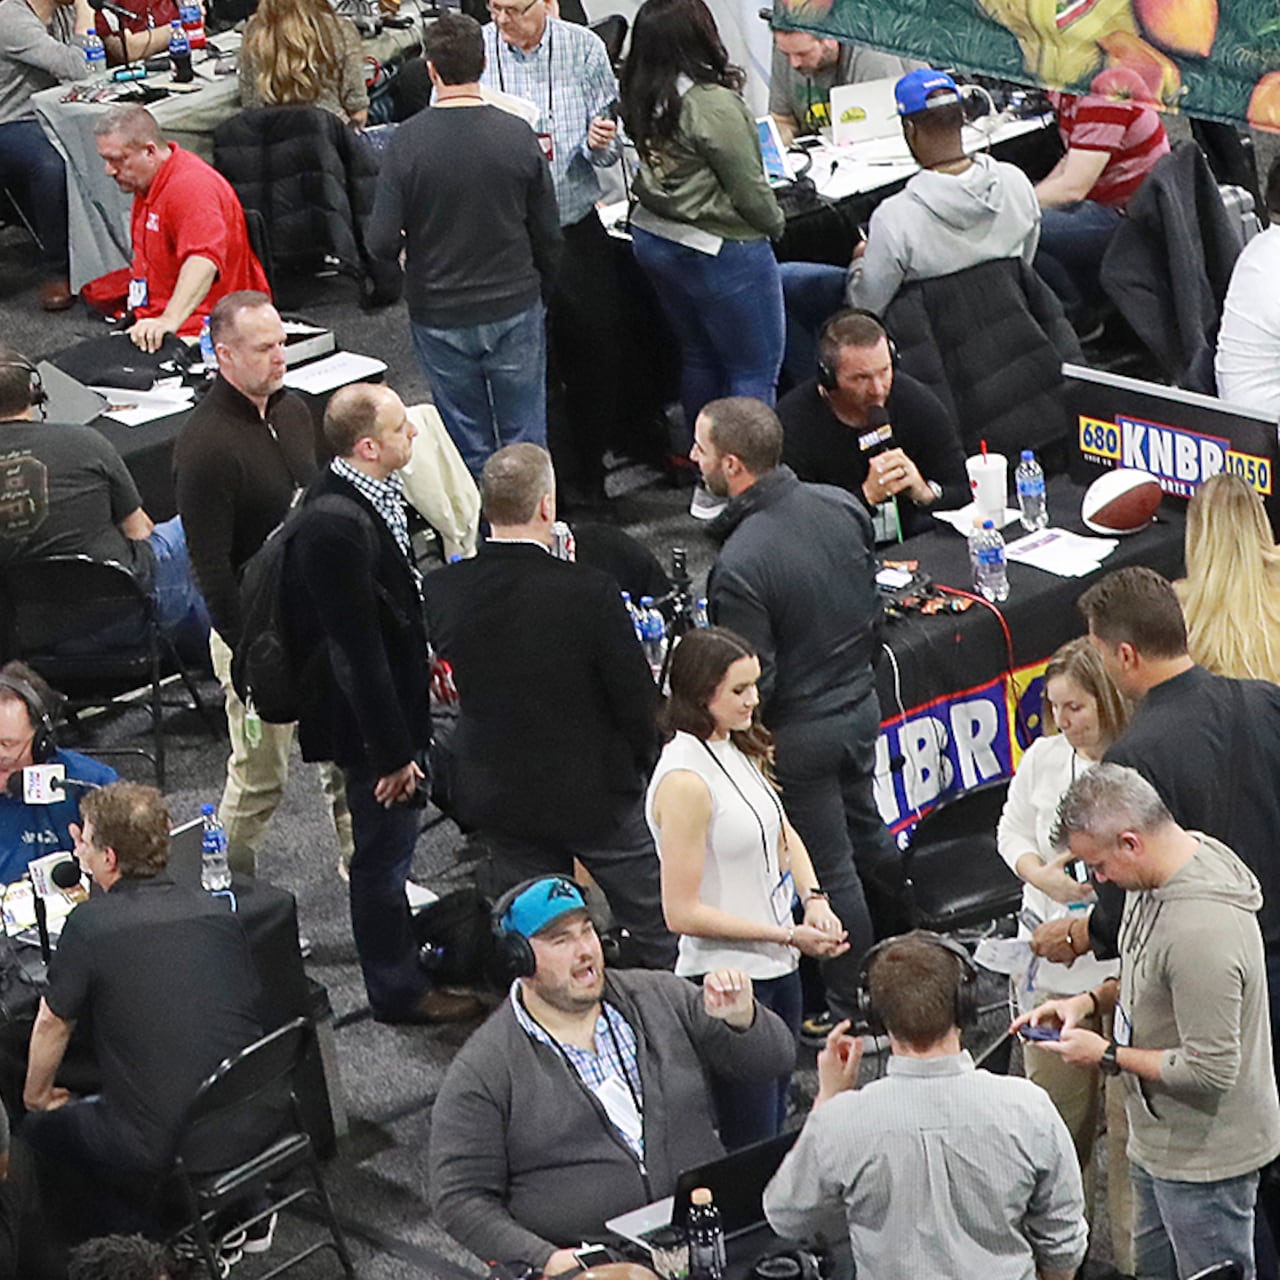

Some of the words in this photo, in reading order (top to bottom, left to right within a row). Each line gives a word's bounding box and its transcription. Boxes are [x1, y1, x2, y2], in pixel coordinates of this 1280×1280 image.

[1083, 422, 1118, 454] 680
[1122, 420, 1224, 484] KNBR
[1228, 453, 1269, 489] 1050
